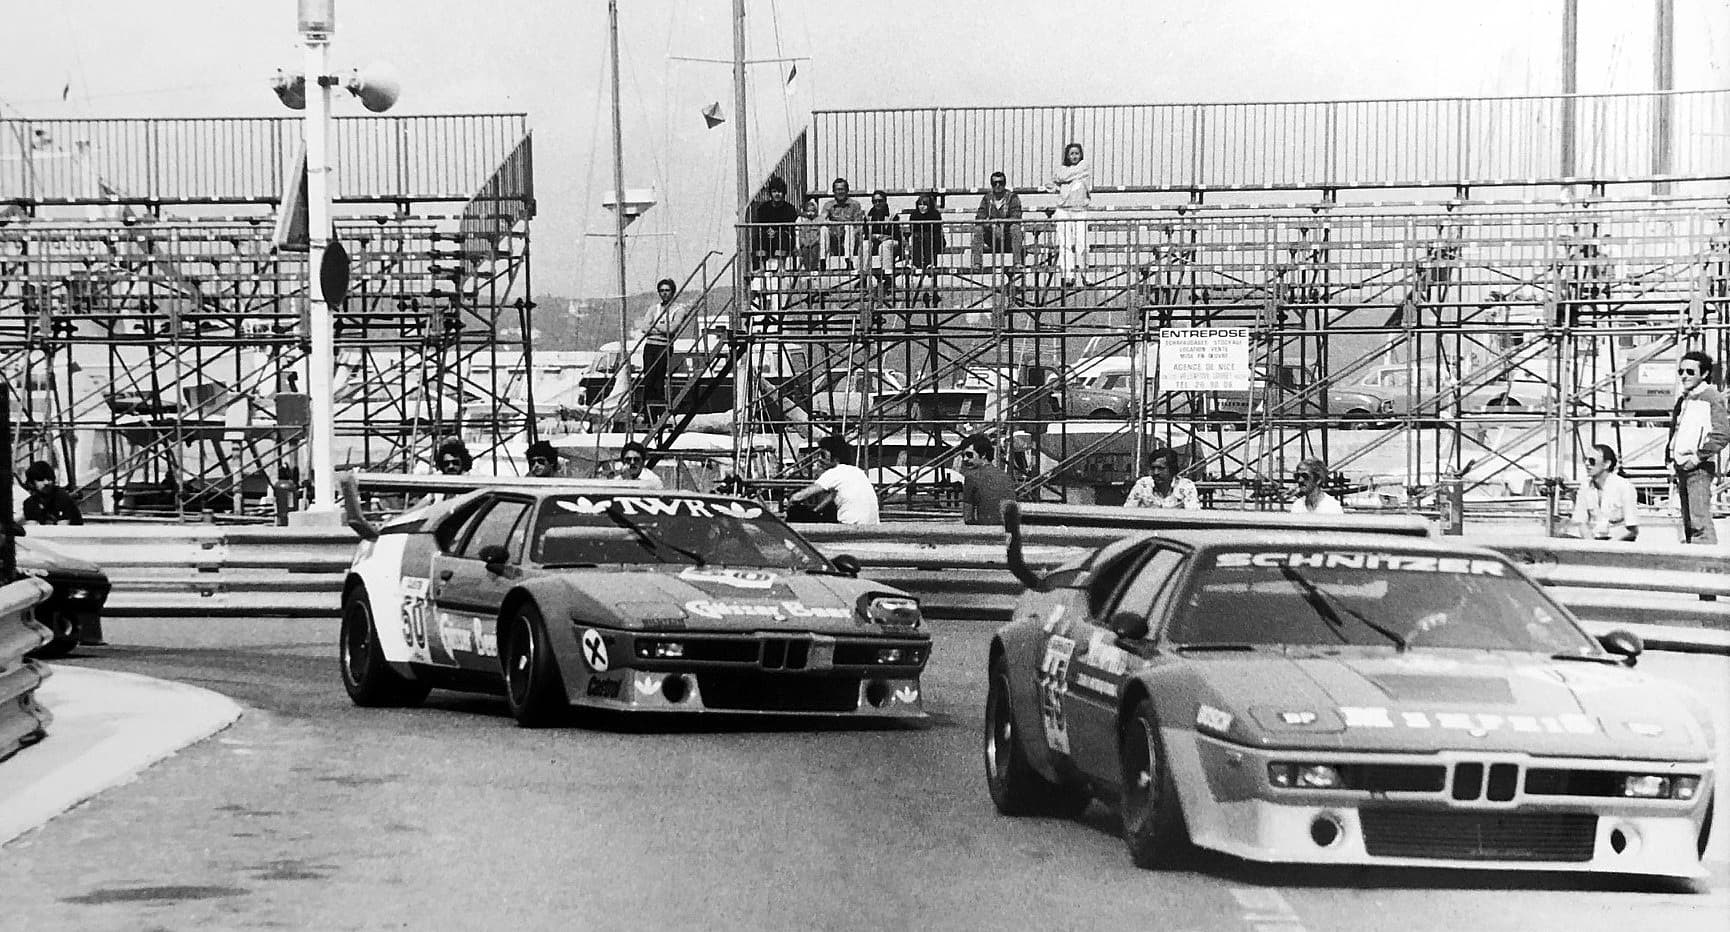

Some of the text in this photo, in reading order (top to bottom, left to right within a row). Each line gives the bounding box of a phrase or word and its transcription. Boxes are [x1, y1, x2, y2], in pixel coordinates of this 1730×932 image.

[1161, 329, 1247, 338] ENTREPOSE
[1173, 363, 1201, 371] AGENCE
[1218, 363, 1235, 371] NICE
[613, 496, 715, 517] TWR
[1215, 550, 1504, 576] SCHNITZER
